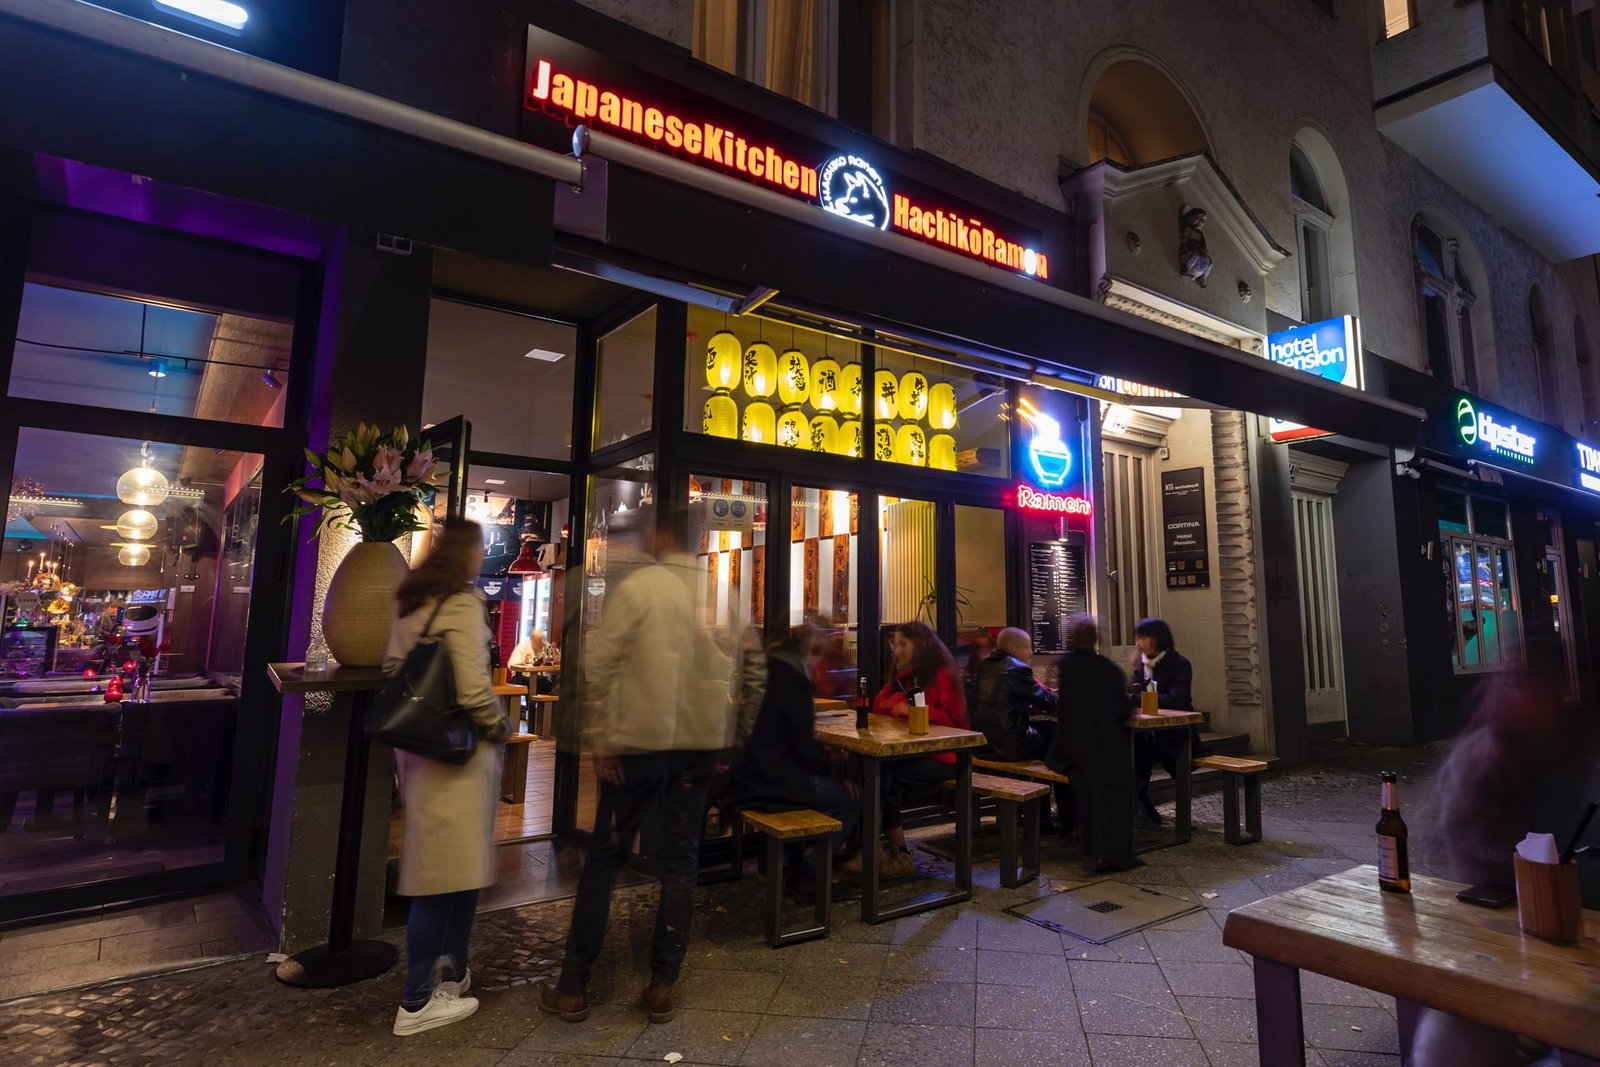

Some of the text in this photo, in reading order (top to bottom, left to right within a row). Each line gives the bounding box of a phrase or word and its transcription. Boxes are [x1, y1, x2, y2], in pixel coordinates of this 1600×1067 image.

[532, 59, 817, 197] JapaneseKitchen
[1270, 333, 1318, 362] hotel
[1478, 412, 1536, 457] tipster
[1018, 484, 1092, 515] Ramen
[1167, 521, 1200, 530] CORTINA
